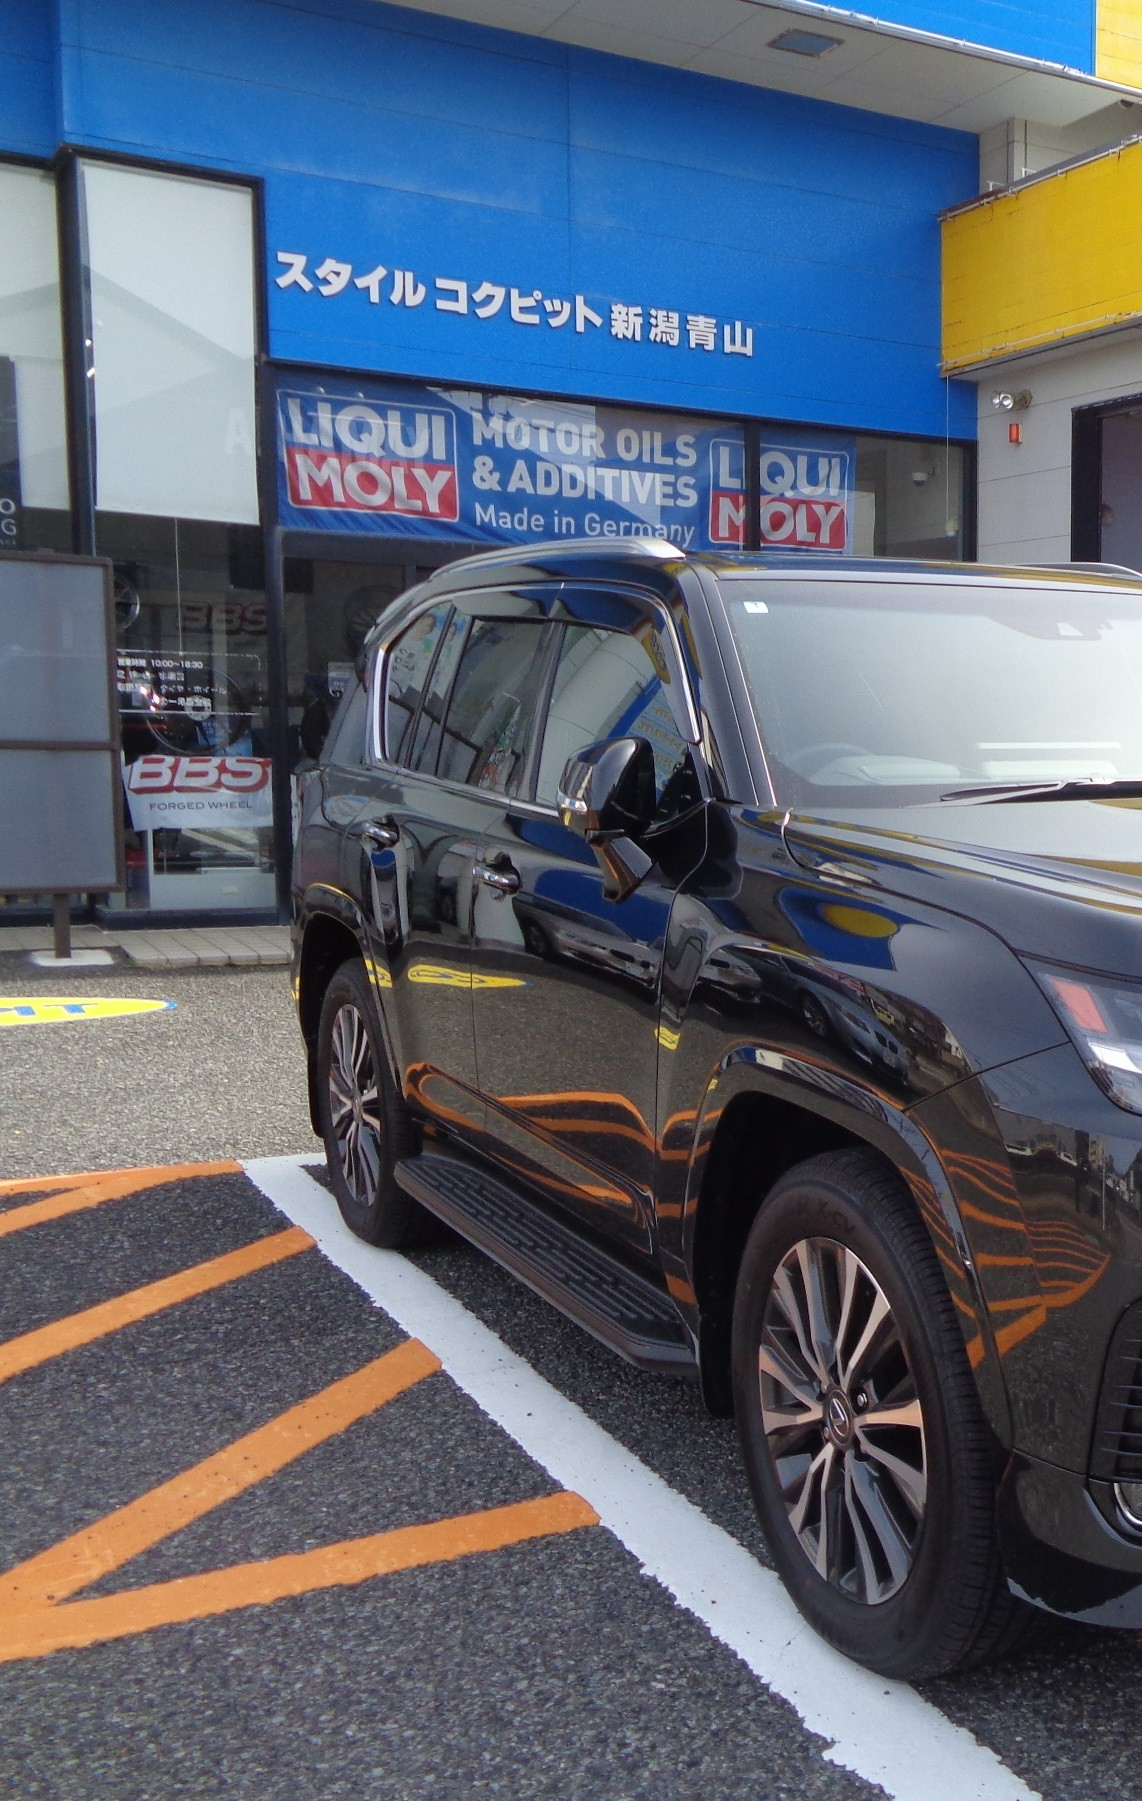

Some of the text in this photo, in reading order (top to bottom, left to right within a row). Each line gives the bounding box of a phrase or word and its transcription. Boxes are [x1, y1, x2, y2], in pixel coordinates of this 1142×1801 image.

[275, 251, 755, 357] スタイル コクピット 新潟青山
[287, 397, 447, 460] LIQUI
[472, 410, 698, 467] MOTOR OILS
[295, 453, 453, 513] MOLY
[472, 455, 698, 507] & ADDITIVES
[719, 446, 840, 497] LQUI
[475, 502, 695, 548] Made in Germany
[128, 754, 272, 795] BBS
[149, 801, 254, 811] FORGED WHEEL
